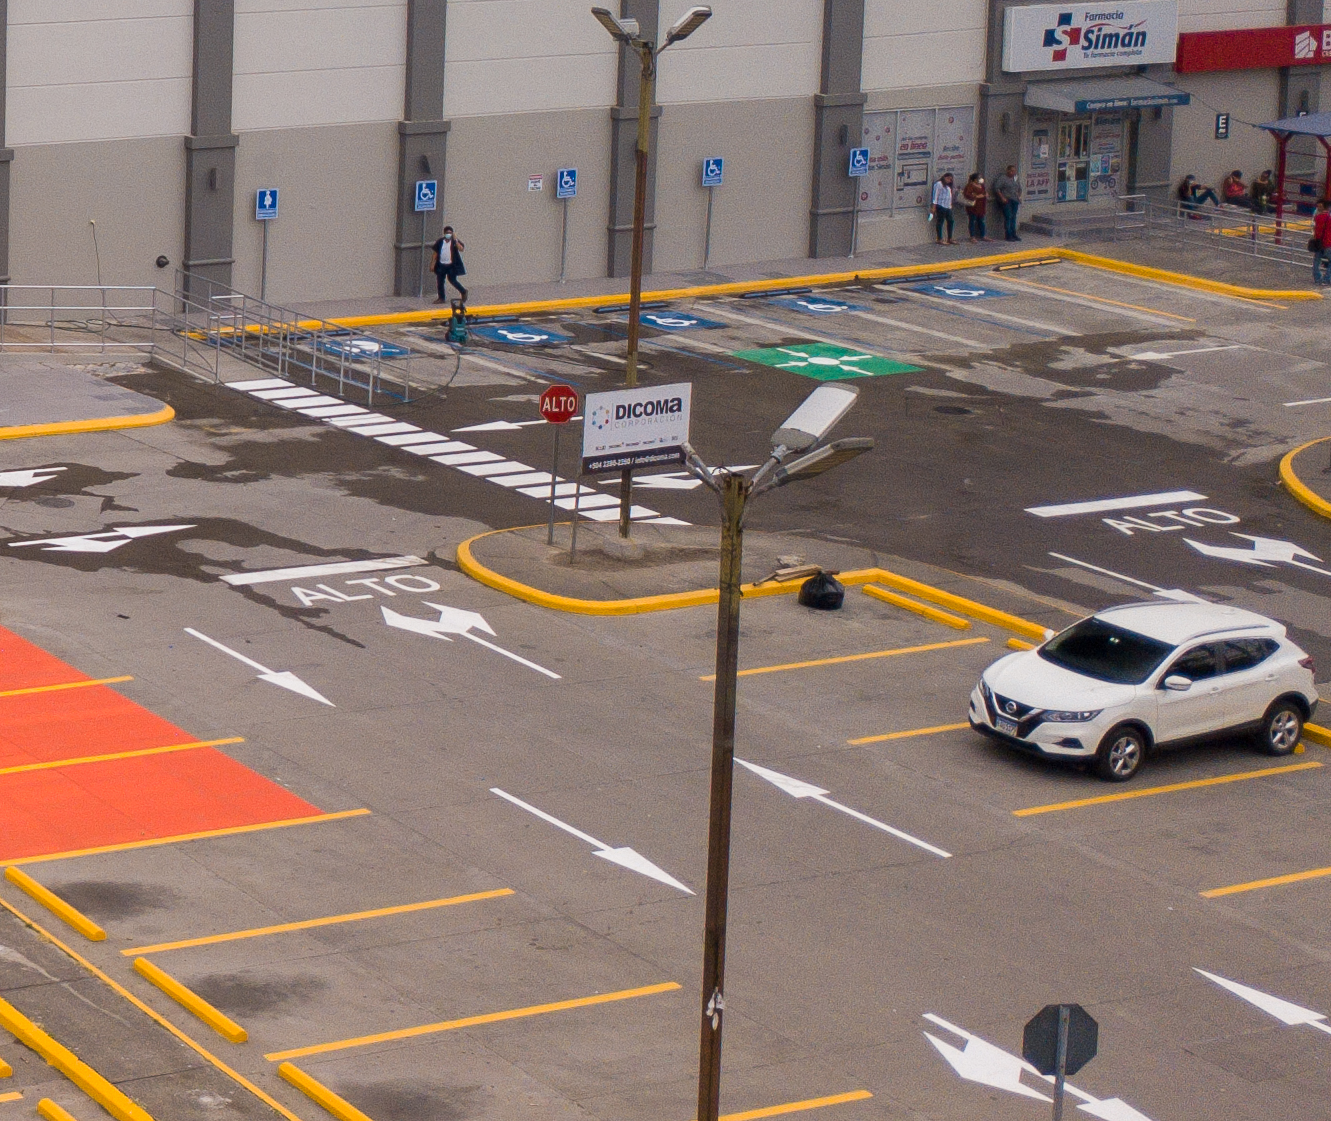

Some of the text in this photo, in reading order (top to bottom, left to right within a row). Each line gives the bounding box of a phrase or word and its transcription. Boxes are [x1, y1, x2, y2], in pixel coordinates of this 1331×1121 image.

[1085, 10, 1124, 21] Farmacia
[1081, 24, 1147, 51] Simán
[1219, 116, 1227, 128] E
[542, 396, 576, 412] ALTO
[1101, 507, 1241, 536] ALTO
[290, 574, 441, 607] ALTO
